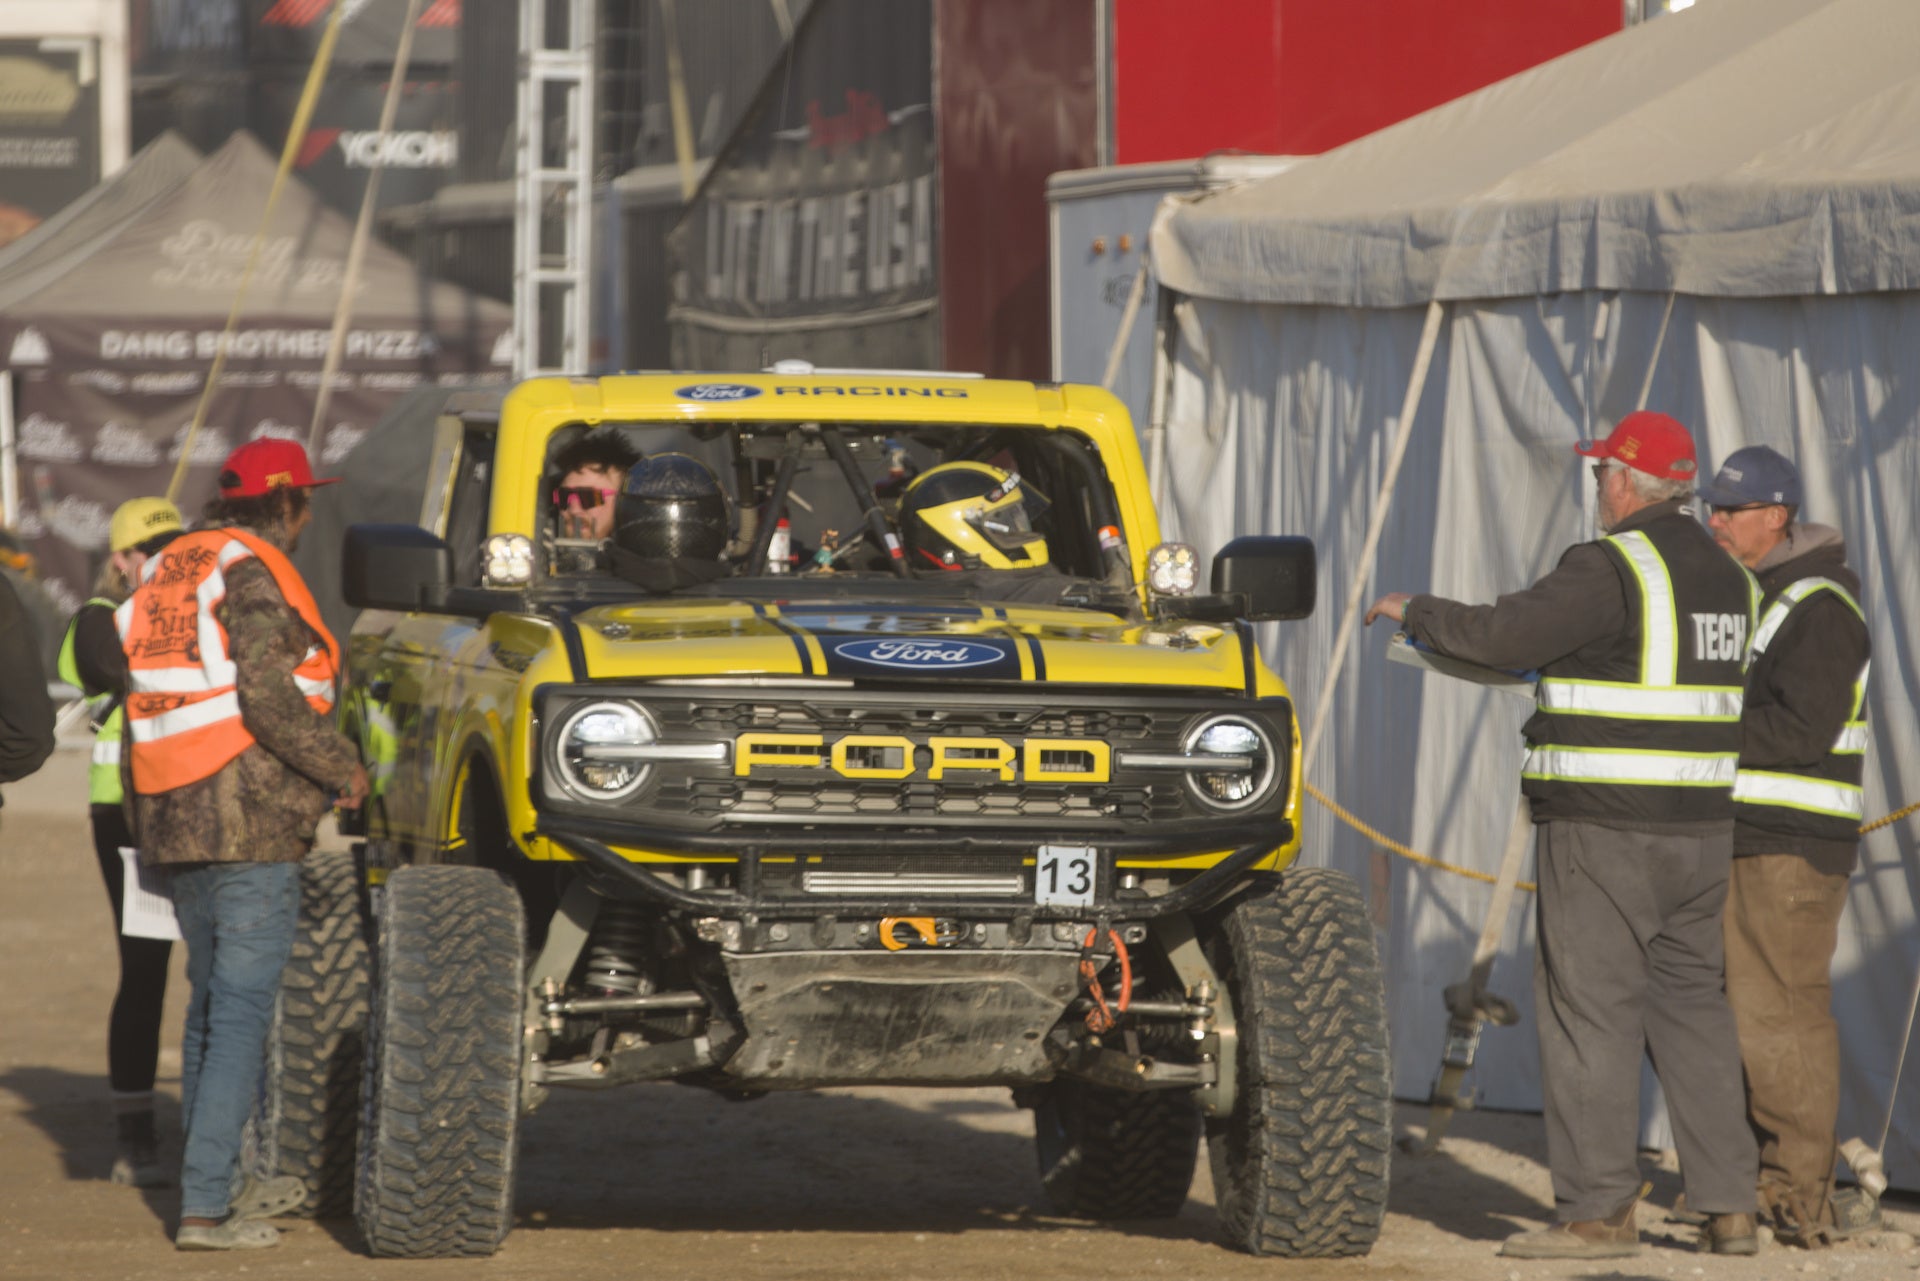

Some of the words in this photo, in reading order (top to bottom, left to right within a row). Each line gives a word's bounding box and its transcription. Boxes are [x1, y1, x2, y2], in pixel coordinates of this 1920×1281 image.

[101, 330, 192, 360] DANG
[690, 383, 747, 401] Ford
[773, 385, 970, 399] RACING
[869, 641, 970, 663] Ford
[1690, 612, 1747, 662] TECH
[735, 732, 1111, 783] FORD
[1041, 857, 1092, 896] 13
